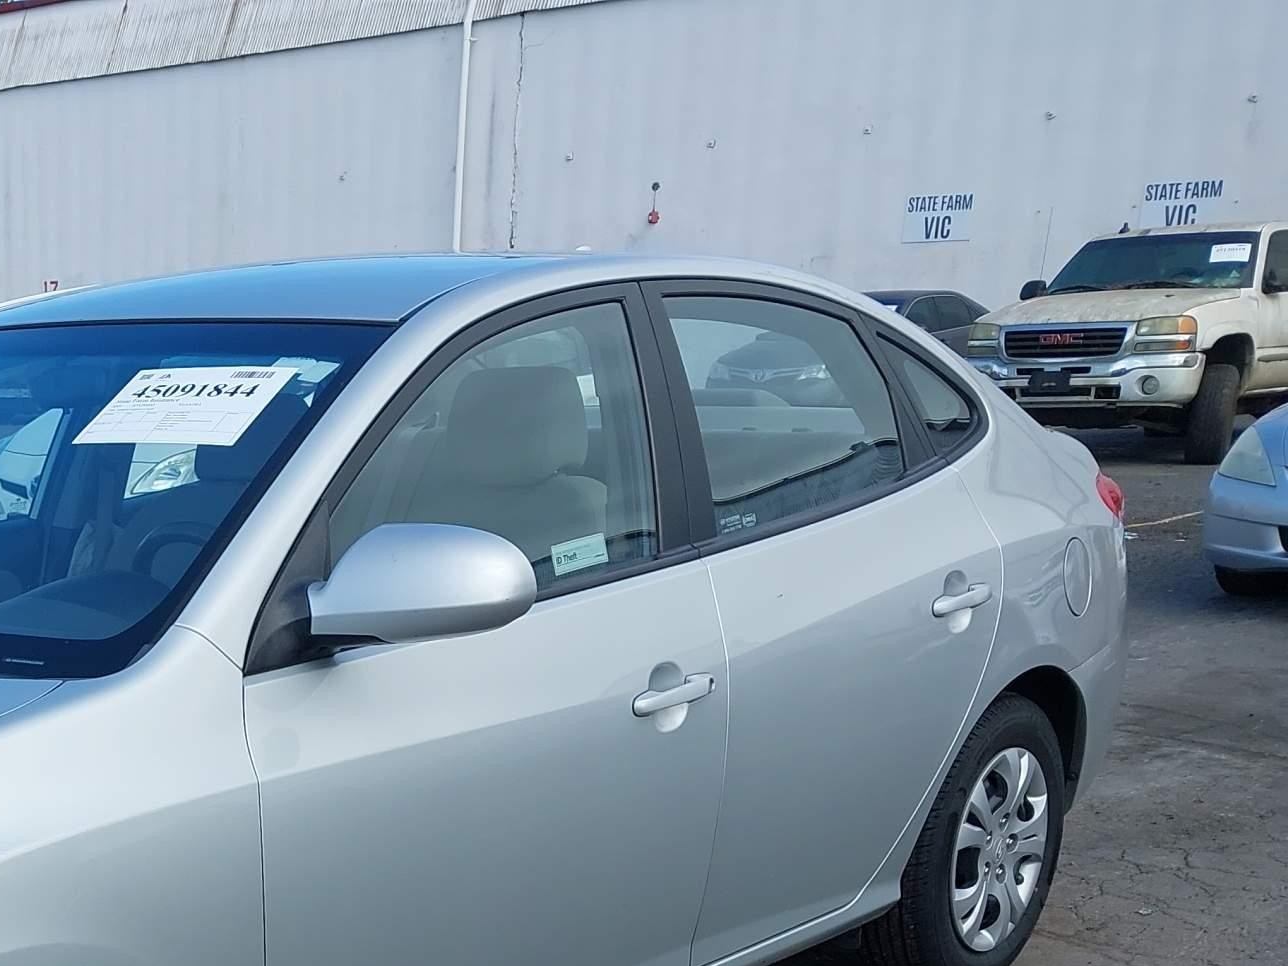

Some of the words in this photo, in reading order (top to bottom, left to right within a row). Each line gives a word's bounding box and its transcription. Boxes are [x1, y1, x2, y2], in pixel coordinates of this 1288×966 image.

[1145, 183, 1182, 201] STATE
[1184, 180, 1223, 199] FARM
[908, 196, 938, 212] STATE
[941, 194, 973, 211] FARM
[1165, 204, 1197, 226] VIC
[925, 215, 951, 239] VIC
[43, 280, 59, 293] 17
[1040, 333, 1084, 344] GMC
[132, 384, 260, 398] 45091844
